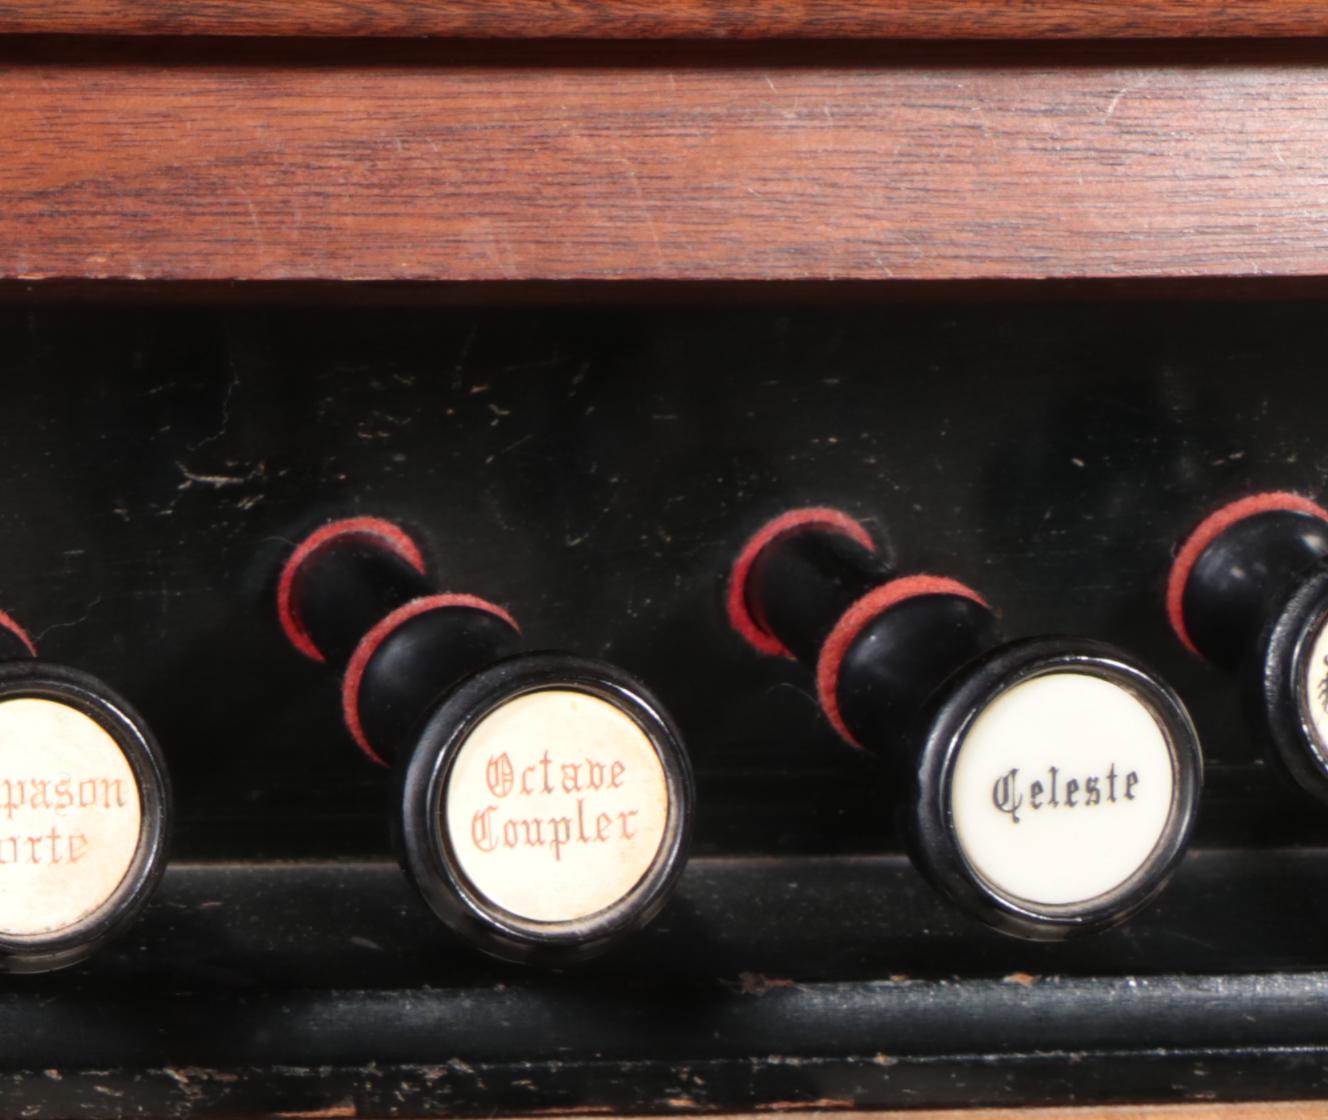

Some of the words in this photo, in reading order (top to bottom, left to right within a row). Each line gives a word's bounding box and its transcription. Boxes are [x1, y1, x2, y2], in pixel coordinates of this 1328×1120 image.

[485, 750, 626, 799] Octave
[992, 762, 1140, 824] Celeste
[471, 799, 639, 862] Coupler
